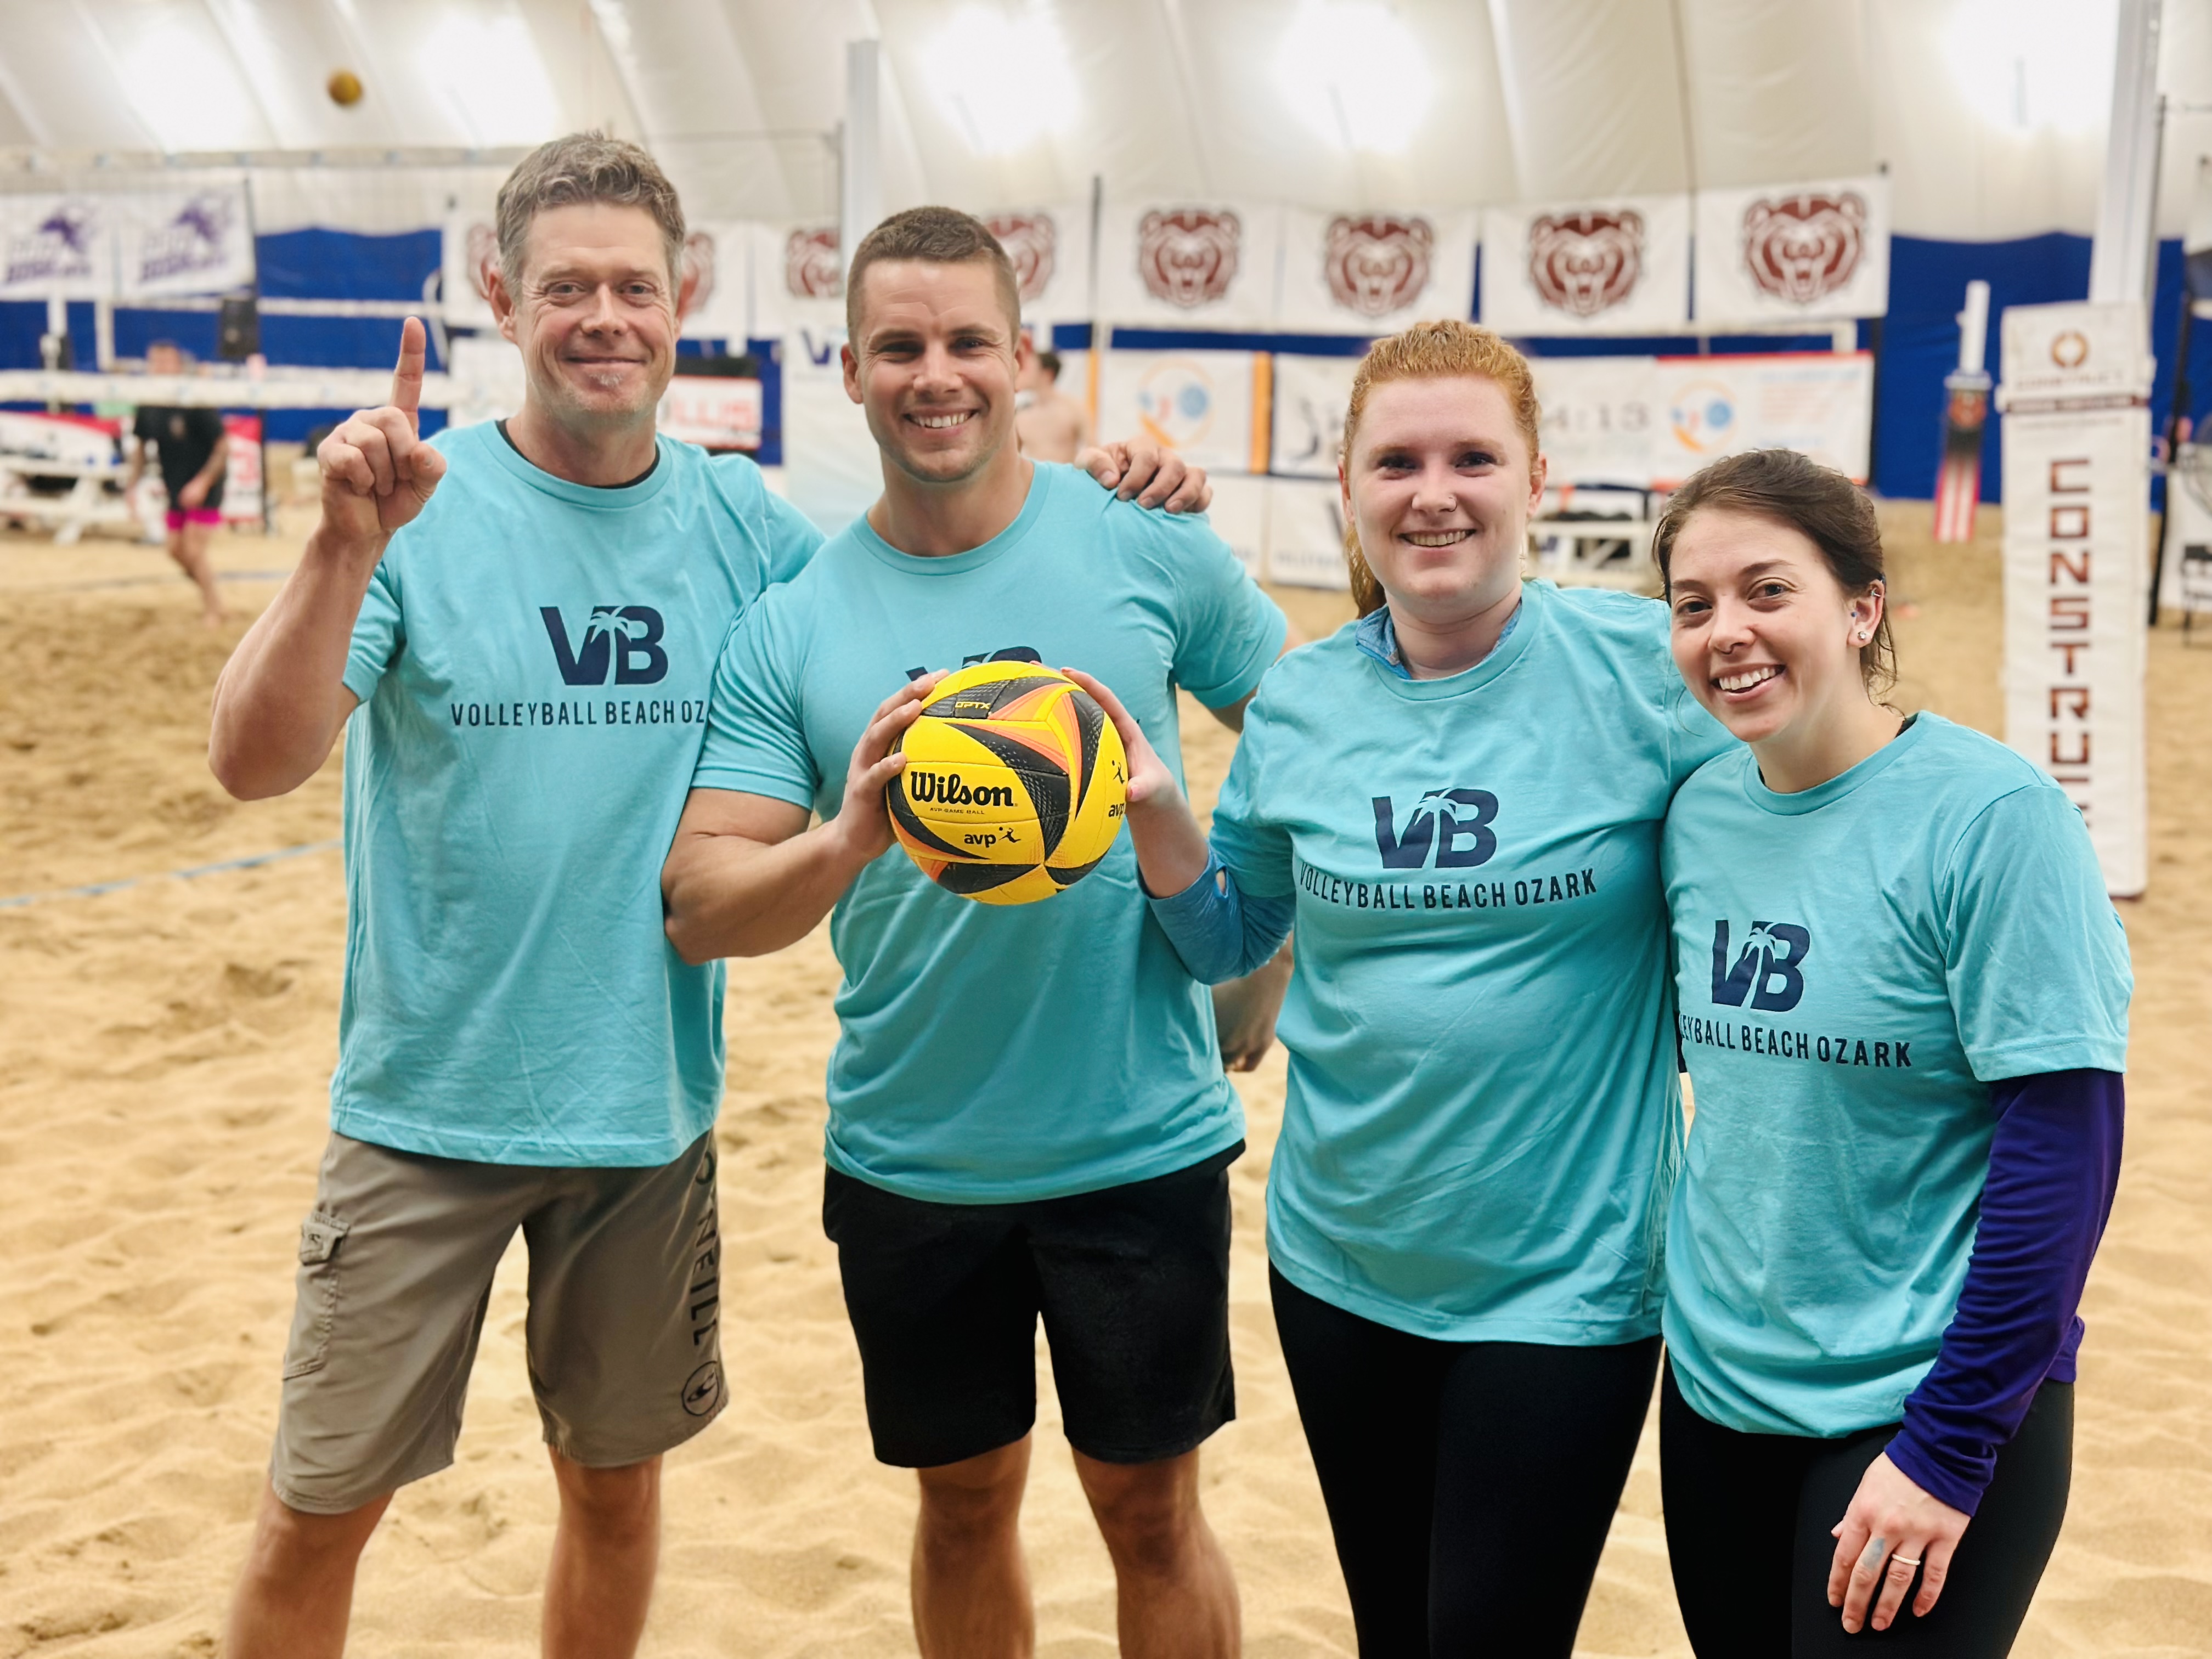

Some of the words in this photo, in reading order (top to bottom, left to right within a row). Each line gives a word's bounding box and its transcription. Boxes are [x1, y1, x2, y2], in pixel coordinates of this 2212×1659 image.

[539, 605, 669, 686] VB
[2049, 459, 2091, 830] CONSTRU
[451, 702, 597, 726] VOLLEYBALL
[605, 700, 675, 725] BEACH
[910, 771, 1015, 807] Wilson
[964, 832, 996, 848] avp
[1372, 787, 1499, 869] VB
[1300, 861, 1415, 910] VOLLEYBALL
[1424, 882, 1506, 909] BEACH
[1514, 868, 1597, 906] OZARK
[1711, 919, 1810, 1012] VB
[1741, 1025, 1809, 1060] BEACH
[1817, 1035, 1912, 1068] OZARK
